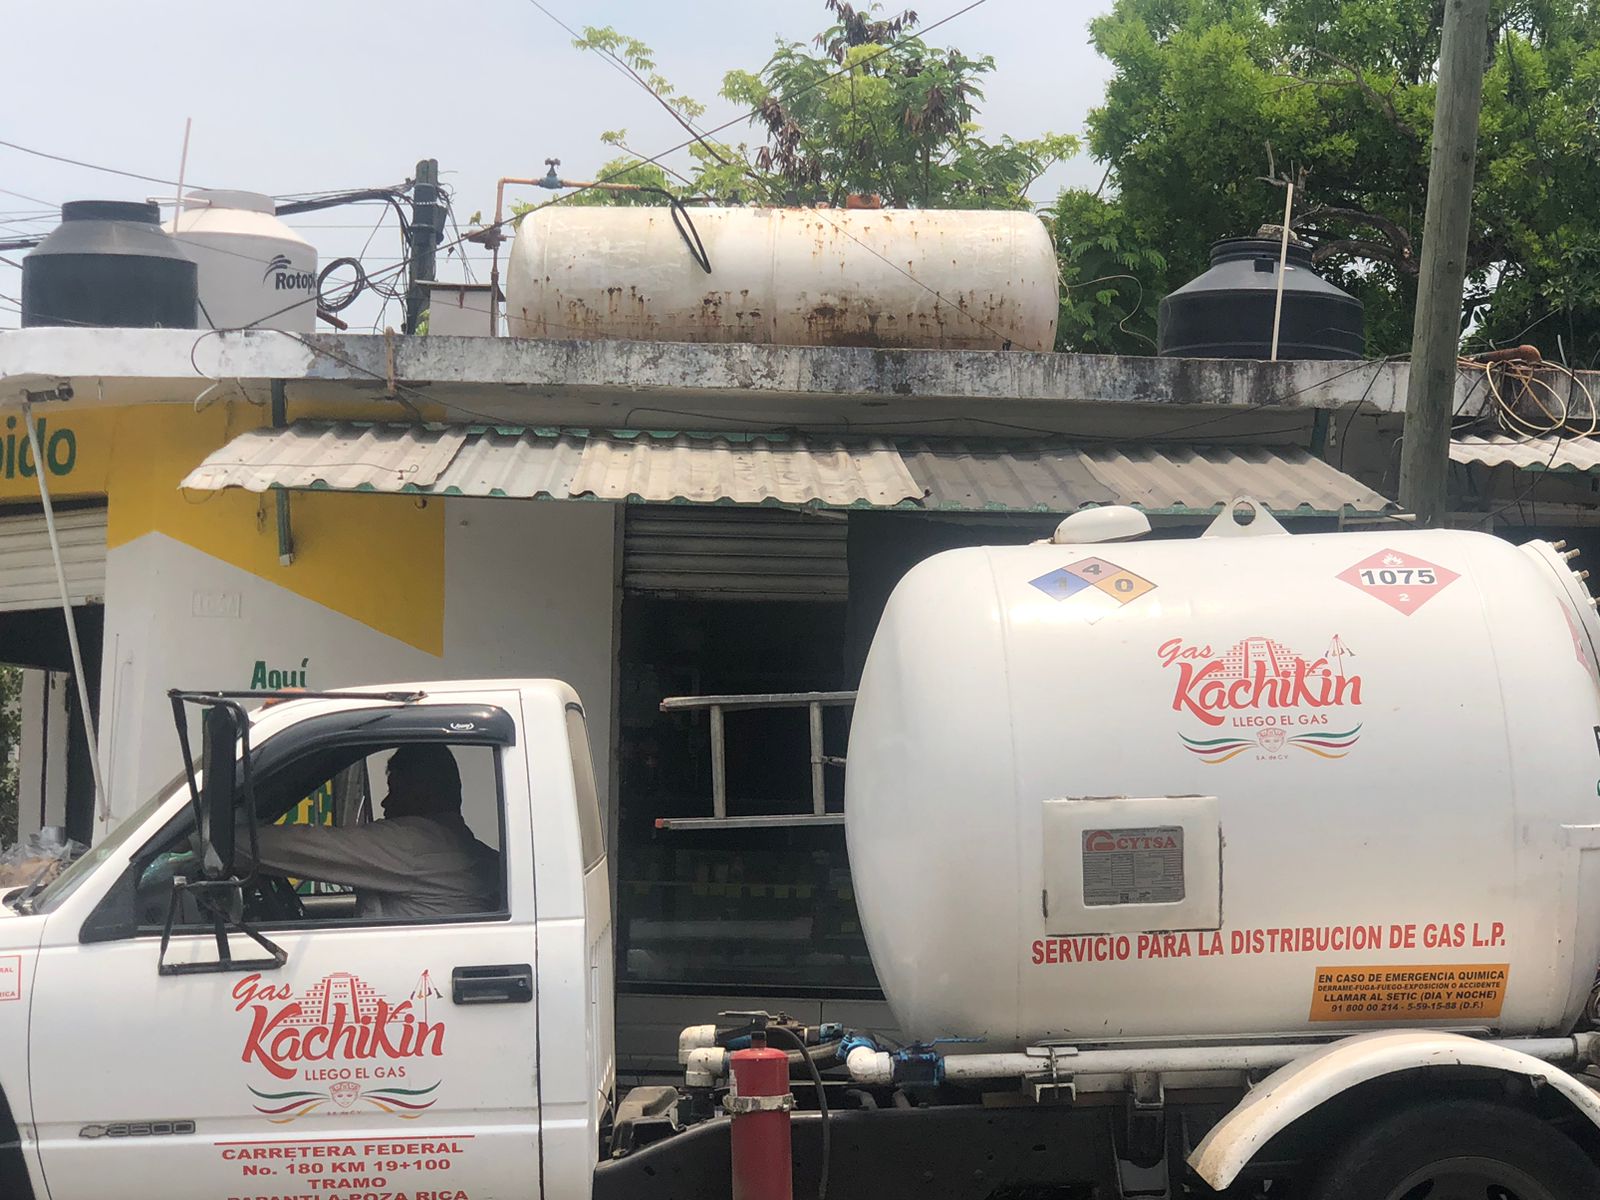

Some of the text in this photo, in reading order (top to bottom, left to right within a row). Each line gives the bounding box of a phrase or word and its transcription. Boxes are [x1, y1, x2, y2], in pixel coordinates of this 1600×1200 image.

[0, 415, 77, 479] ido
[1082, 563, 1102, 576] 4
[1361, 569, 1435, 585] 1075
[1114, 578, 1134, 592] 0
[1398, 592, 1410, 602] 2
[1157, 637, 1215, 668] Gas
[250, 657, 309, 690] Aquí
[1232, 713, 1328, 728] LLEGO EL GAS
[1116, 836, 1177, 849] CYTSA
[1032, 922, 1506, 965] SERVICIO PARA LA DISTRIBUCION DE GAS L.P.
[1318, 970, 1505, 983] EN CASO DE EMERGENCIA QUIMICA
[232, 973, 293, 1012] Gas
[1324, 990, 1497, 1002] LLAMAR AL SETIC (DIA Y NOCHE)
[1331, 1004, 1342, 1012] 91
[1366, 1003, 1378, 1012] 00
[1381, 1003, 1399, 1011] 214
[1459, 1001, 1484, 1011] (D.F.)
[305, 1066, 406, 1081] LLEGO EL GAS
[222, 1142, 464, 1160] CARRETERA FEDERAL
[242, 1159, 451, 1176] No. 180 KM 19+100
[307, 1177, 387, 1190] TRAMO
[415, 1190, 469, 1200] RICA
